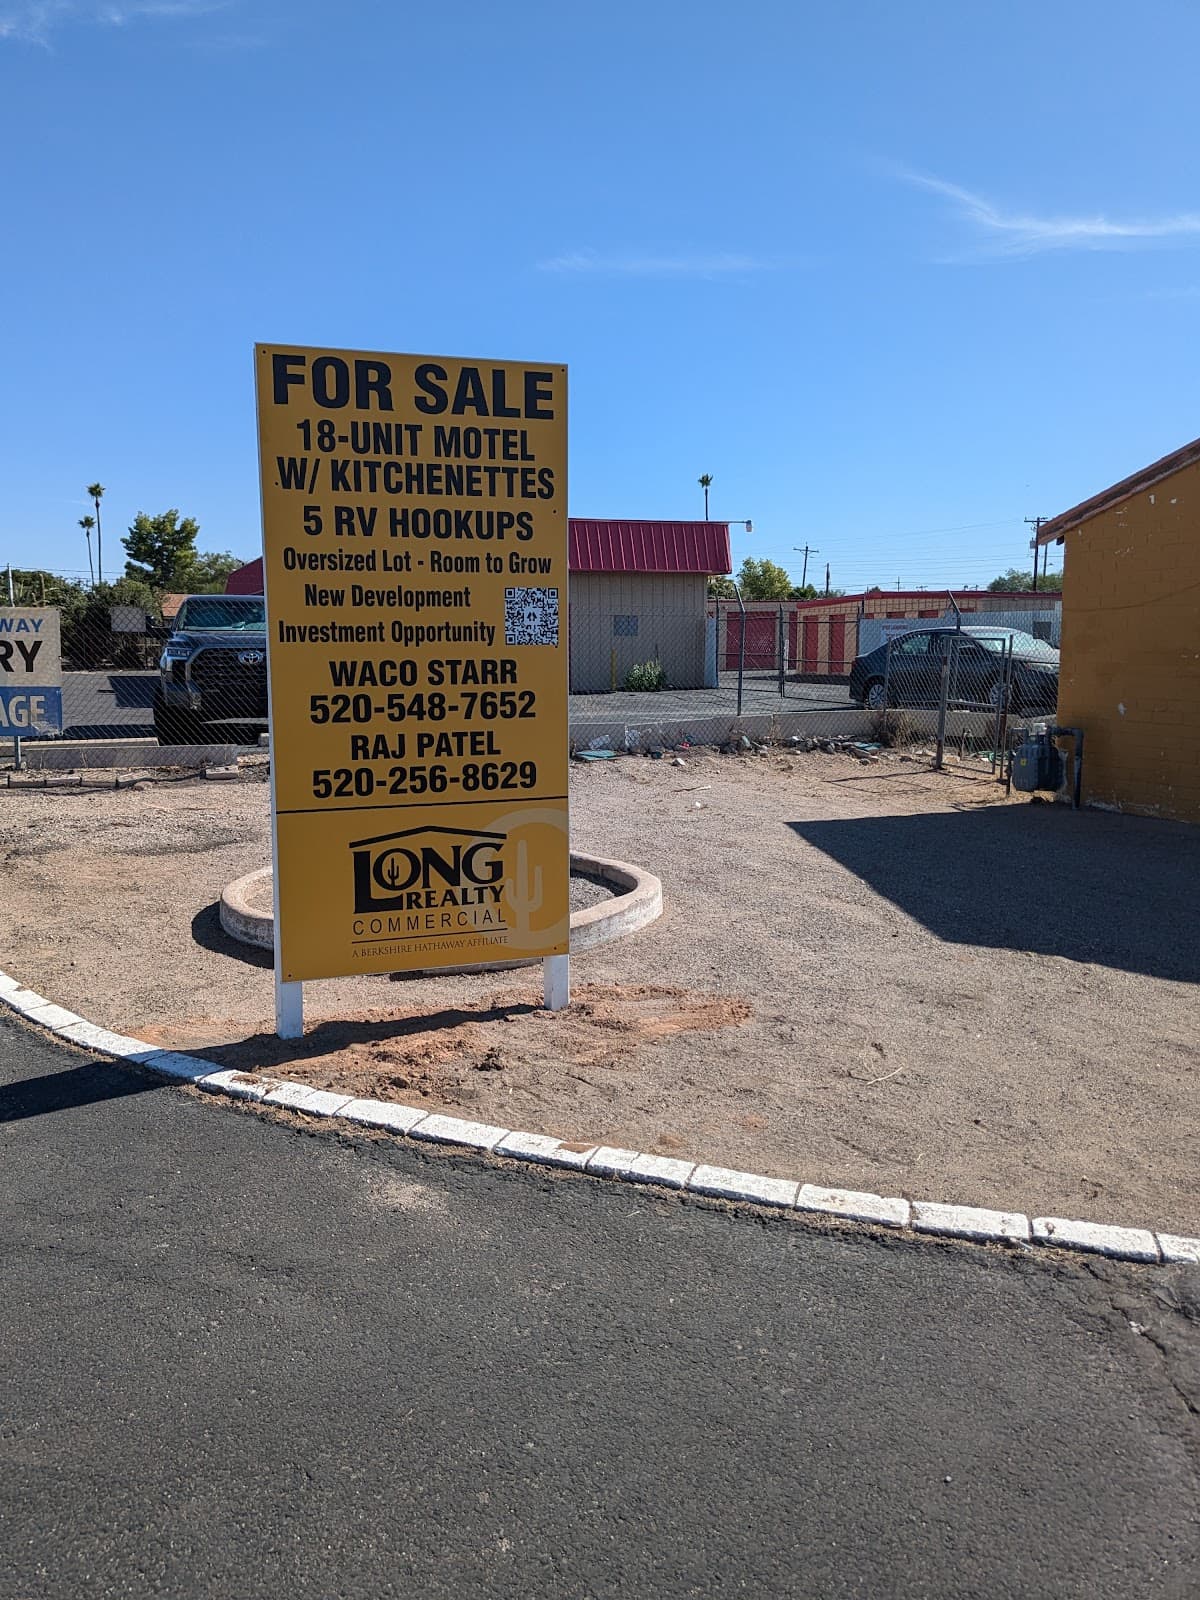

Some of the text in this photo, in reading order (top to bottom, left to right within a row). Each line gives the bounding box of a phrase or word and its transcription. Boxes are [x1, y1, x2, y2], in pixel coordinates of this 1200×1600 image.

[271, 353, 554, 420] FOR SALE
[297, 418, 535, 462] 18-UNIT MOTEL
[276, 456, 555, 500] W/ KITCHENETTES
[303, 505, 534, 541] 5 RV HOOKUPS
[283, 547, 376, 573] Oversized
[382, 549, 412, 573] Lot
[430, 550, 480, 573] Room
[486, 552, 503, 574] to
[509, 552, 552, 574] Grow
[304, 583, 471, 612] New Development
[0, 618, 43, 632] WAY
[279, 620, 496, 647] Investment Opportunity
[329, 659, 518, 687] WACO STARR
[310, 690, 536, 724] 520-548-7652
[351, 730, 502, 761] RAJ PATEL
[312, 761, 537, 799] 520-256-8629
[352, 842, 505, 915] LONG
[406, 885, 505, 910] REALTY
[353, 909, 506, 935] COMMERCIAL
[351, 935, 509, 958] A BERKSHIRE HATHAWAY AFFILIATE
